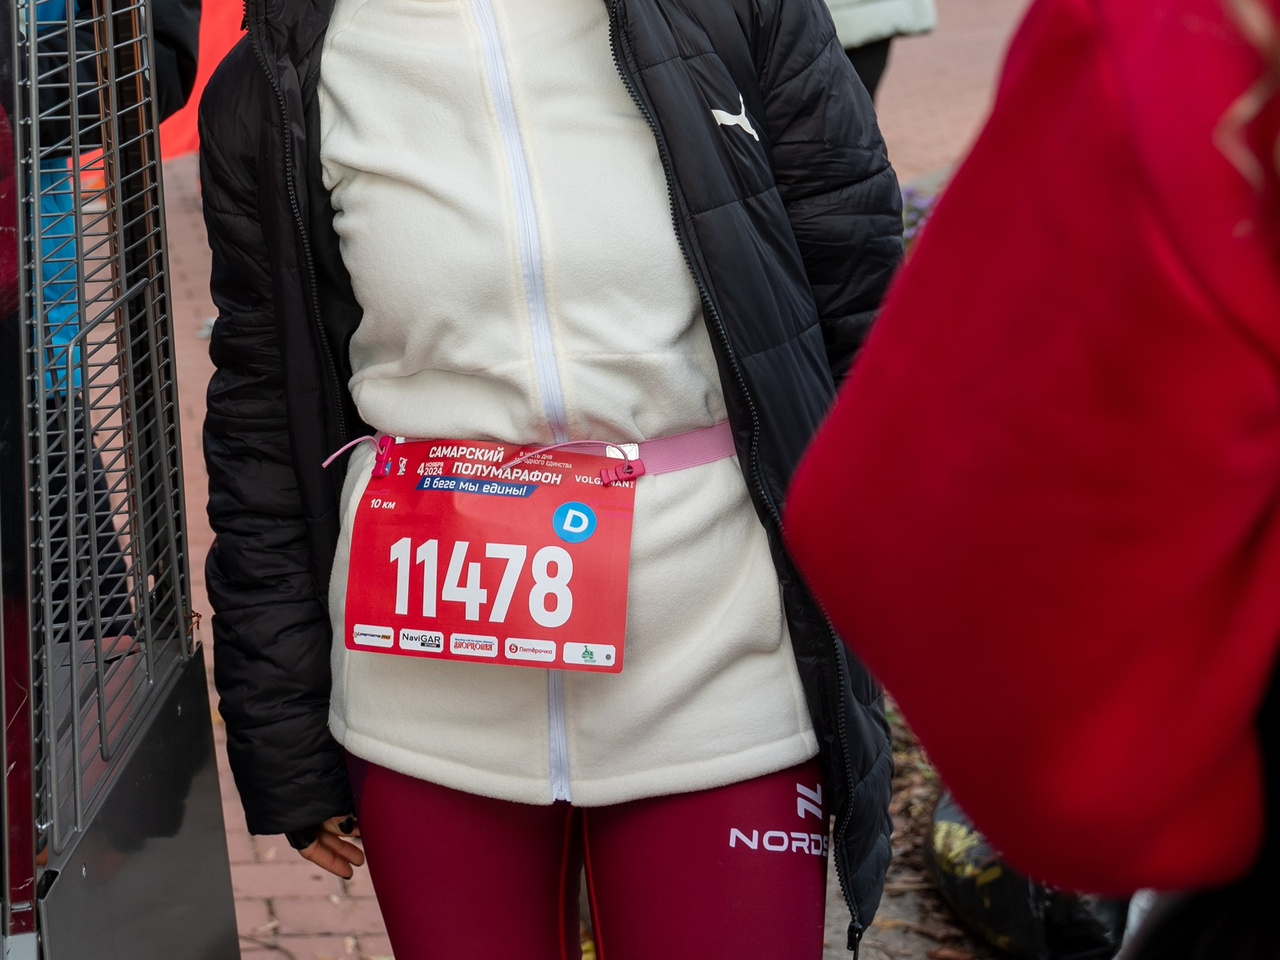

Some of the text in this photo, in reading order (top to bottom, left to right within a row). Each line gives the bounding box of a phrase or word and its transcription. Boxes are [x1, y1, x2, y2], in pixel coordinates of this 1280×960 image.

[429, 446, 504, 463] САМАРСКИЙ
[417, 461, 444, 476] 4 НОЯБРЯ
[424, 467, 443, 476] 2024
[545, 460, 573, 469] ЕДИНСТВА
[452, 462, 562, 485] ПОЛУМАРАФОН
[423, 477, 527, 496] В беге мы едины!
[370, 498, 396, 510] 10 км
[563, 509, 589, 533] D
[389, 537, 574, 628] 11478
[402, 632, 441, 644] NaviGAR
[519, 647, 553, 655] Пятёрочка
